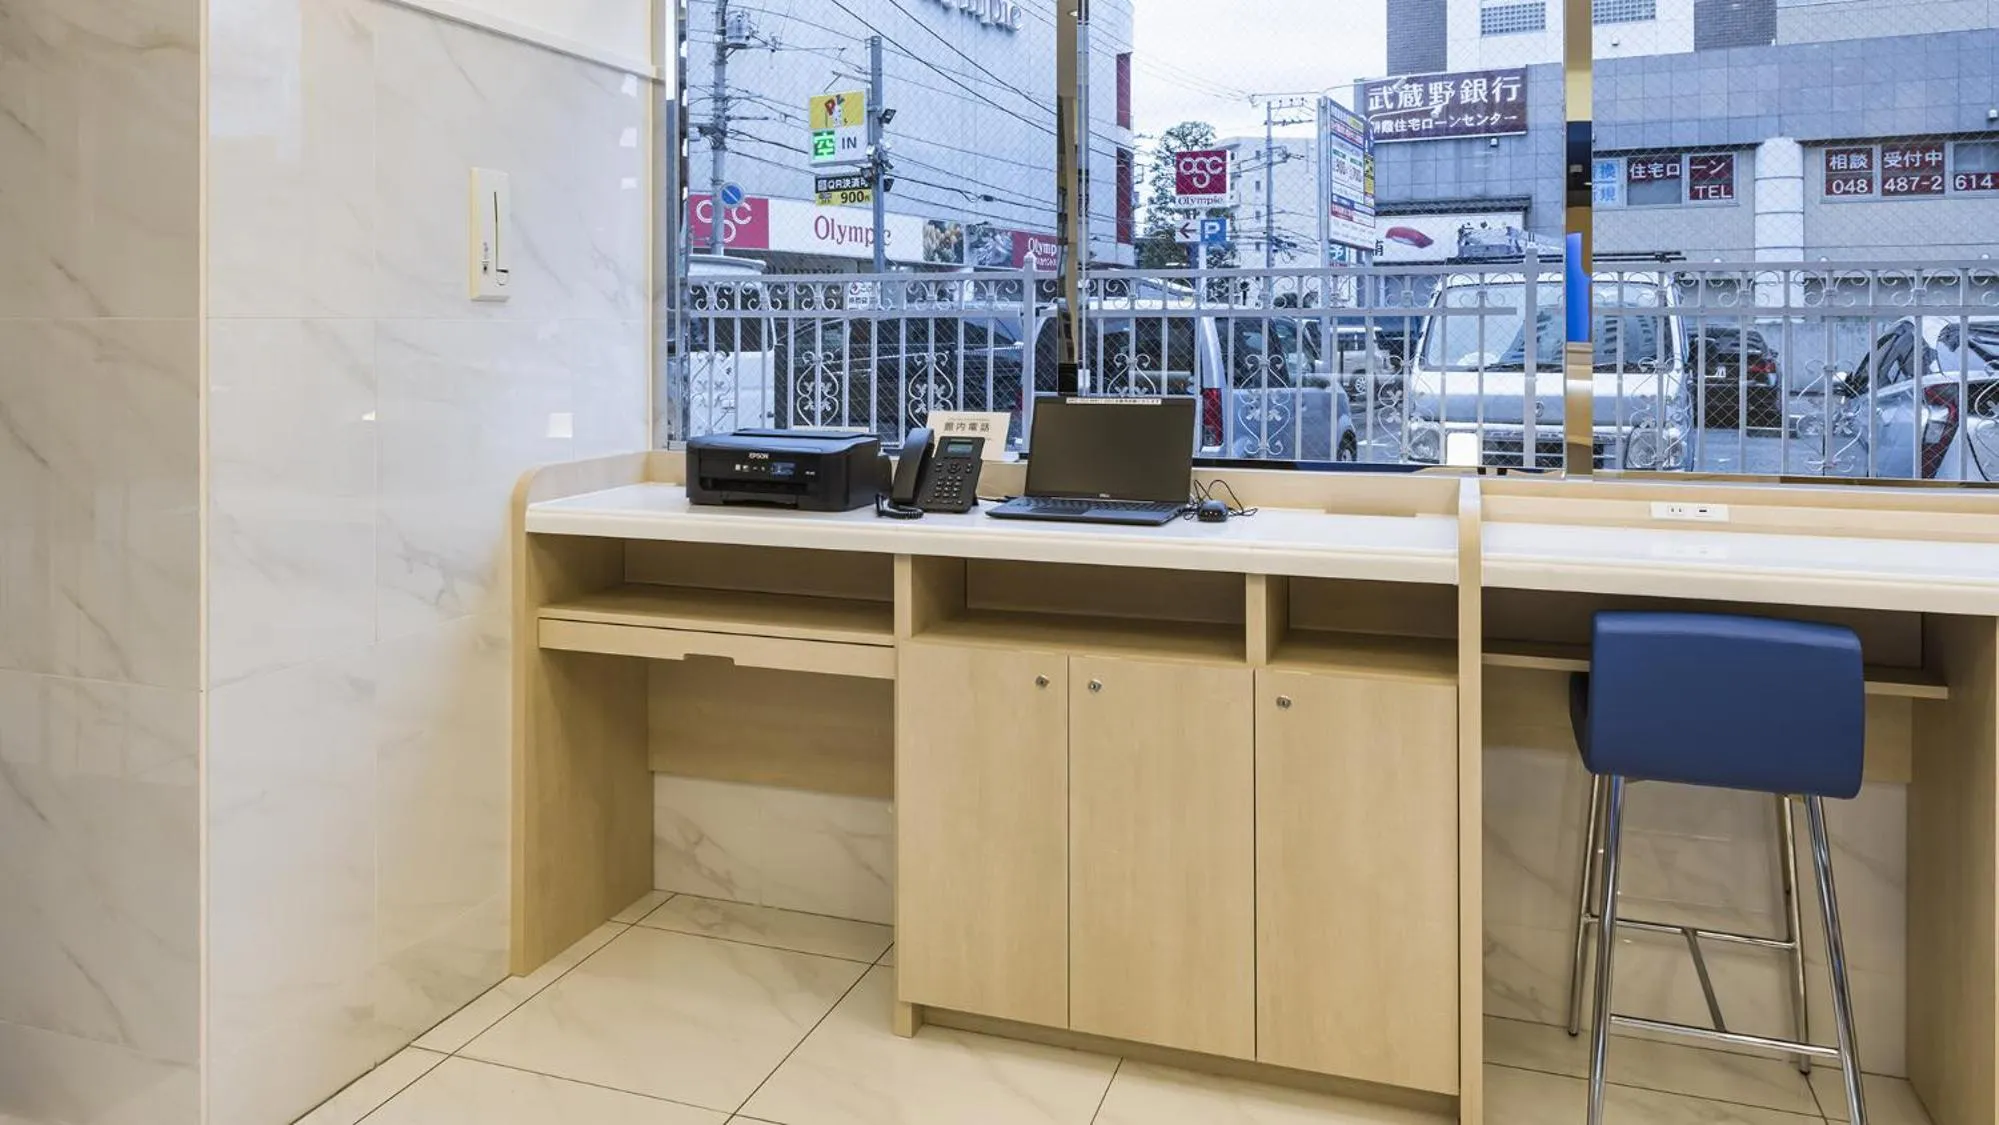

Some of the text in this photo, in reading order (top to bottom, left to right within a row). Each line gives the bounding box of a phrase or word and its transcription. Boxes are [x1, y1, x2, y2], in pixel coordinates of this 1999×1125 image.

[1368, 76, 1522, 111] 武蔵野銀行
[814, 131, 857, 159] 空 IN
[1829, 153, 1868, 170] 相談
[1884, 149, 1943, 168] 受付中
[1694, 184, 1732, 199] TEL
[1832, 179, 1868, 194] 048
[815, 215, 892, 248] Olympc
[1204, 221, 1221, 239] P
[1028, 236, 1058, 257] Olymp
[943, 421, 990, 433] 館内電話
[748, 452, 769, 460] EPSON
